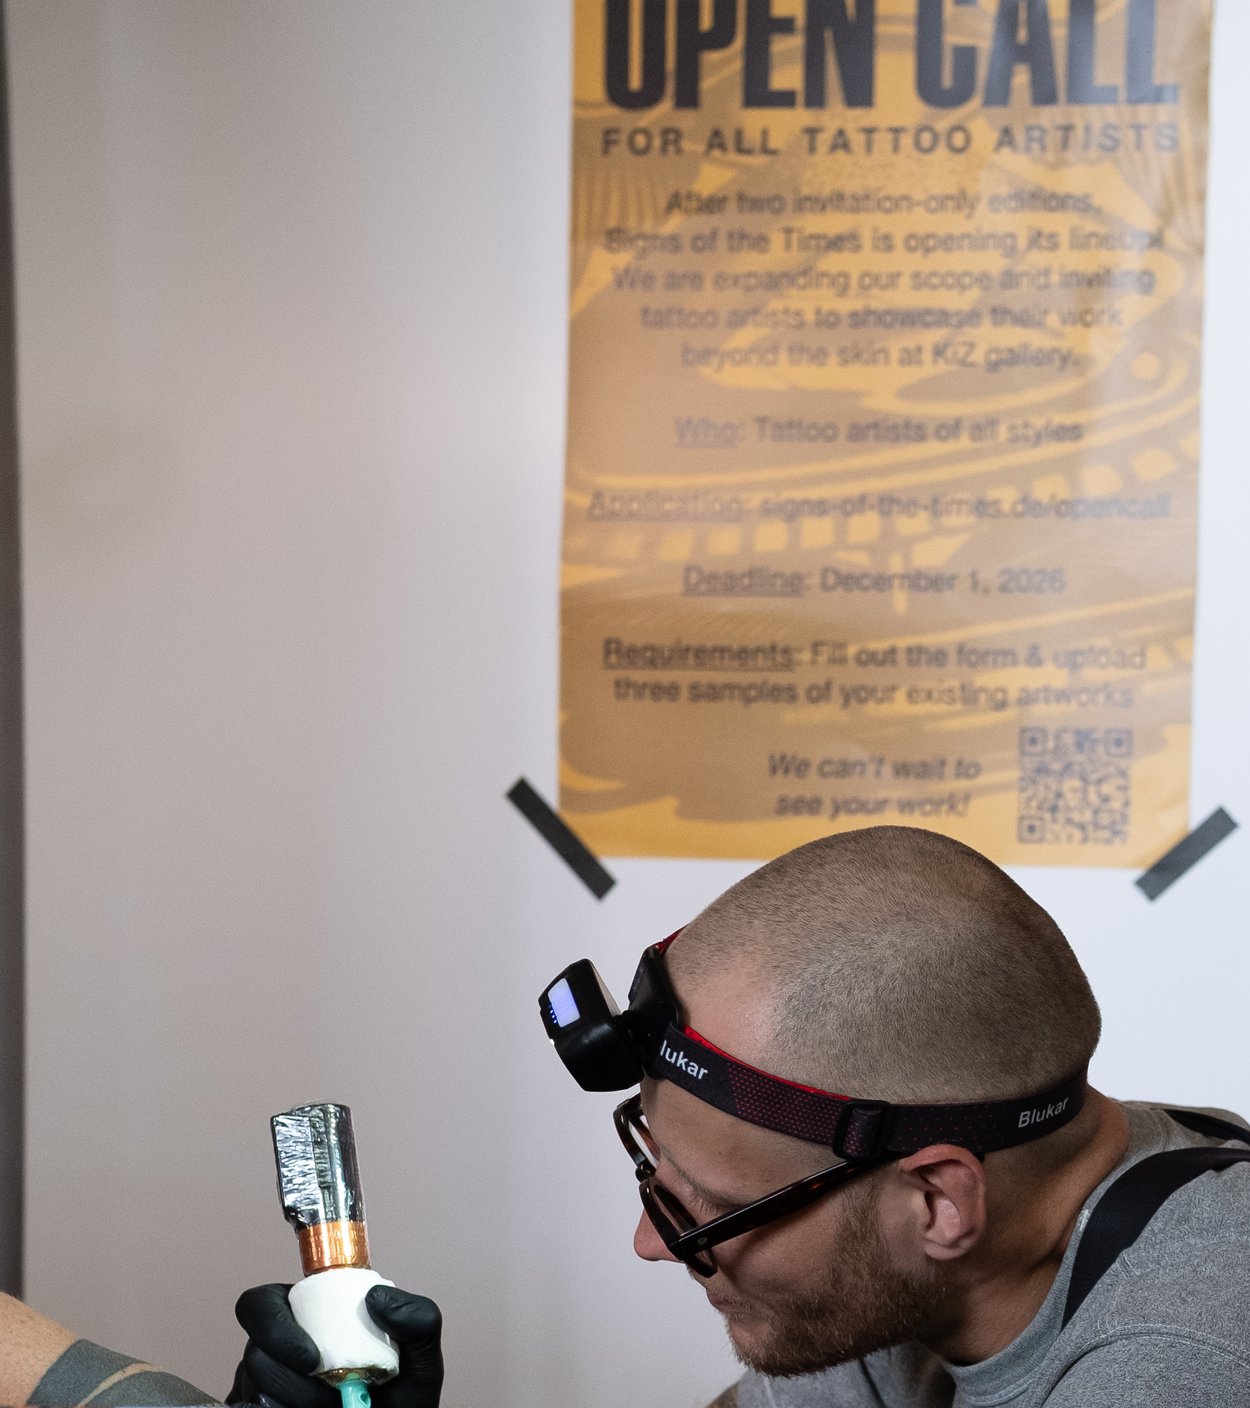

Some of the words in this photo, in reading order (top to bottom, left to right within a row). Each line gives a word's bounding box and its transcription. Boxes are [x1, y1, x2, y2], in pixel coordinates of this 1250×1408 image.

[604, 0, 876, 110] OPEN
[914, 0, 1180, 107] CALL
[601, 126, 685, 157] FOR
[704, 126, 780, 156] ALL
[804, 125, 973, 155] TATTOO
[994, 123, 1180, 154] ARTISTS
[665, 189, 729, 214] After
[736, 190, 787, 214] two
[792, 188, 979, 219] invitation-only
[603, 227, 682, 259] Signs
[689, 227, 720, 252] of
[726, 228, 770, 252] the
[781, 227, 862, 252] Times
[871, 226, 895, 252] is
[903, 227, 1018, 259] opening
[1026, 226, 1060, 252] its
[613, 266, 656, 290] We
[663, 270, 705, 291] are
[712, 267, 851, 297] expanding
[858, 270, 901, 291] our
[910, 270, 993, 297] scope
[998, 266, 1053, 290] and
[641, 306, 719, 329] tattoo
[726, 306, 807, 329] artists
[815, 306, 842, 329] to
[848, 305, 983, 330] showcase
[990, 304, 1051, 329] their
[1058, 305, 1122, 329] work
[681, 343, 779, 373] beyond
[788, 343, 829, 367] the
[837, 341, 891, 367] skin
[898, 344, 924, 367] at
[754, 415, 839, 443] Tattoo
[846, 416, 928, 443] artists
[933, 416, 961, 442] of
[968, 416, 1000, 442] all
[1005, 416, 1085, 447] styles
[820, 565, 959, 593] December
[968, 569, 990, 596] 1,
[810, 640, 847, 666] Fill
[855, 645, 897, 669] out
[906, 643, 948, 669] the
[956, 644, 1018, 669] form
[1026, 645, 1044, 669] &
[1053, 645, 1147, 676] upload
[614, 675, 681, 703] three
[687, 676, 798, 709] samples
[805, 679, 834, 704] of
[840, 684, 898, 711] your
[906, 680, 1009, 712] existing
[768, 753, 812, 779] We
[817, 754, 886, 780] can't
[892, 756, 948, 781] wait
[953, 757, 982, 781] to
[774, 795, 824, 817] see
[831, 796, 890, 821] your
[896, 792, 972, 818] work!
[660, 1039, 708, 1080] lukar
[1018, 1097, 1069, 1128] Blukar
